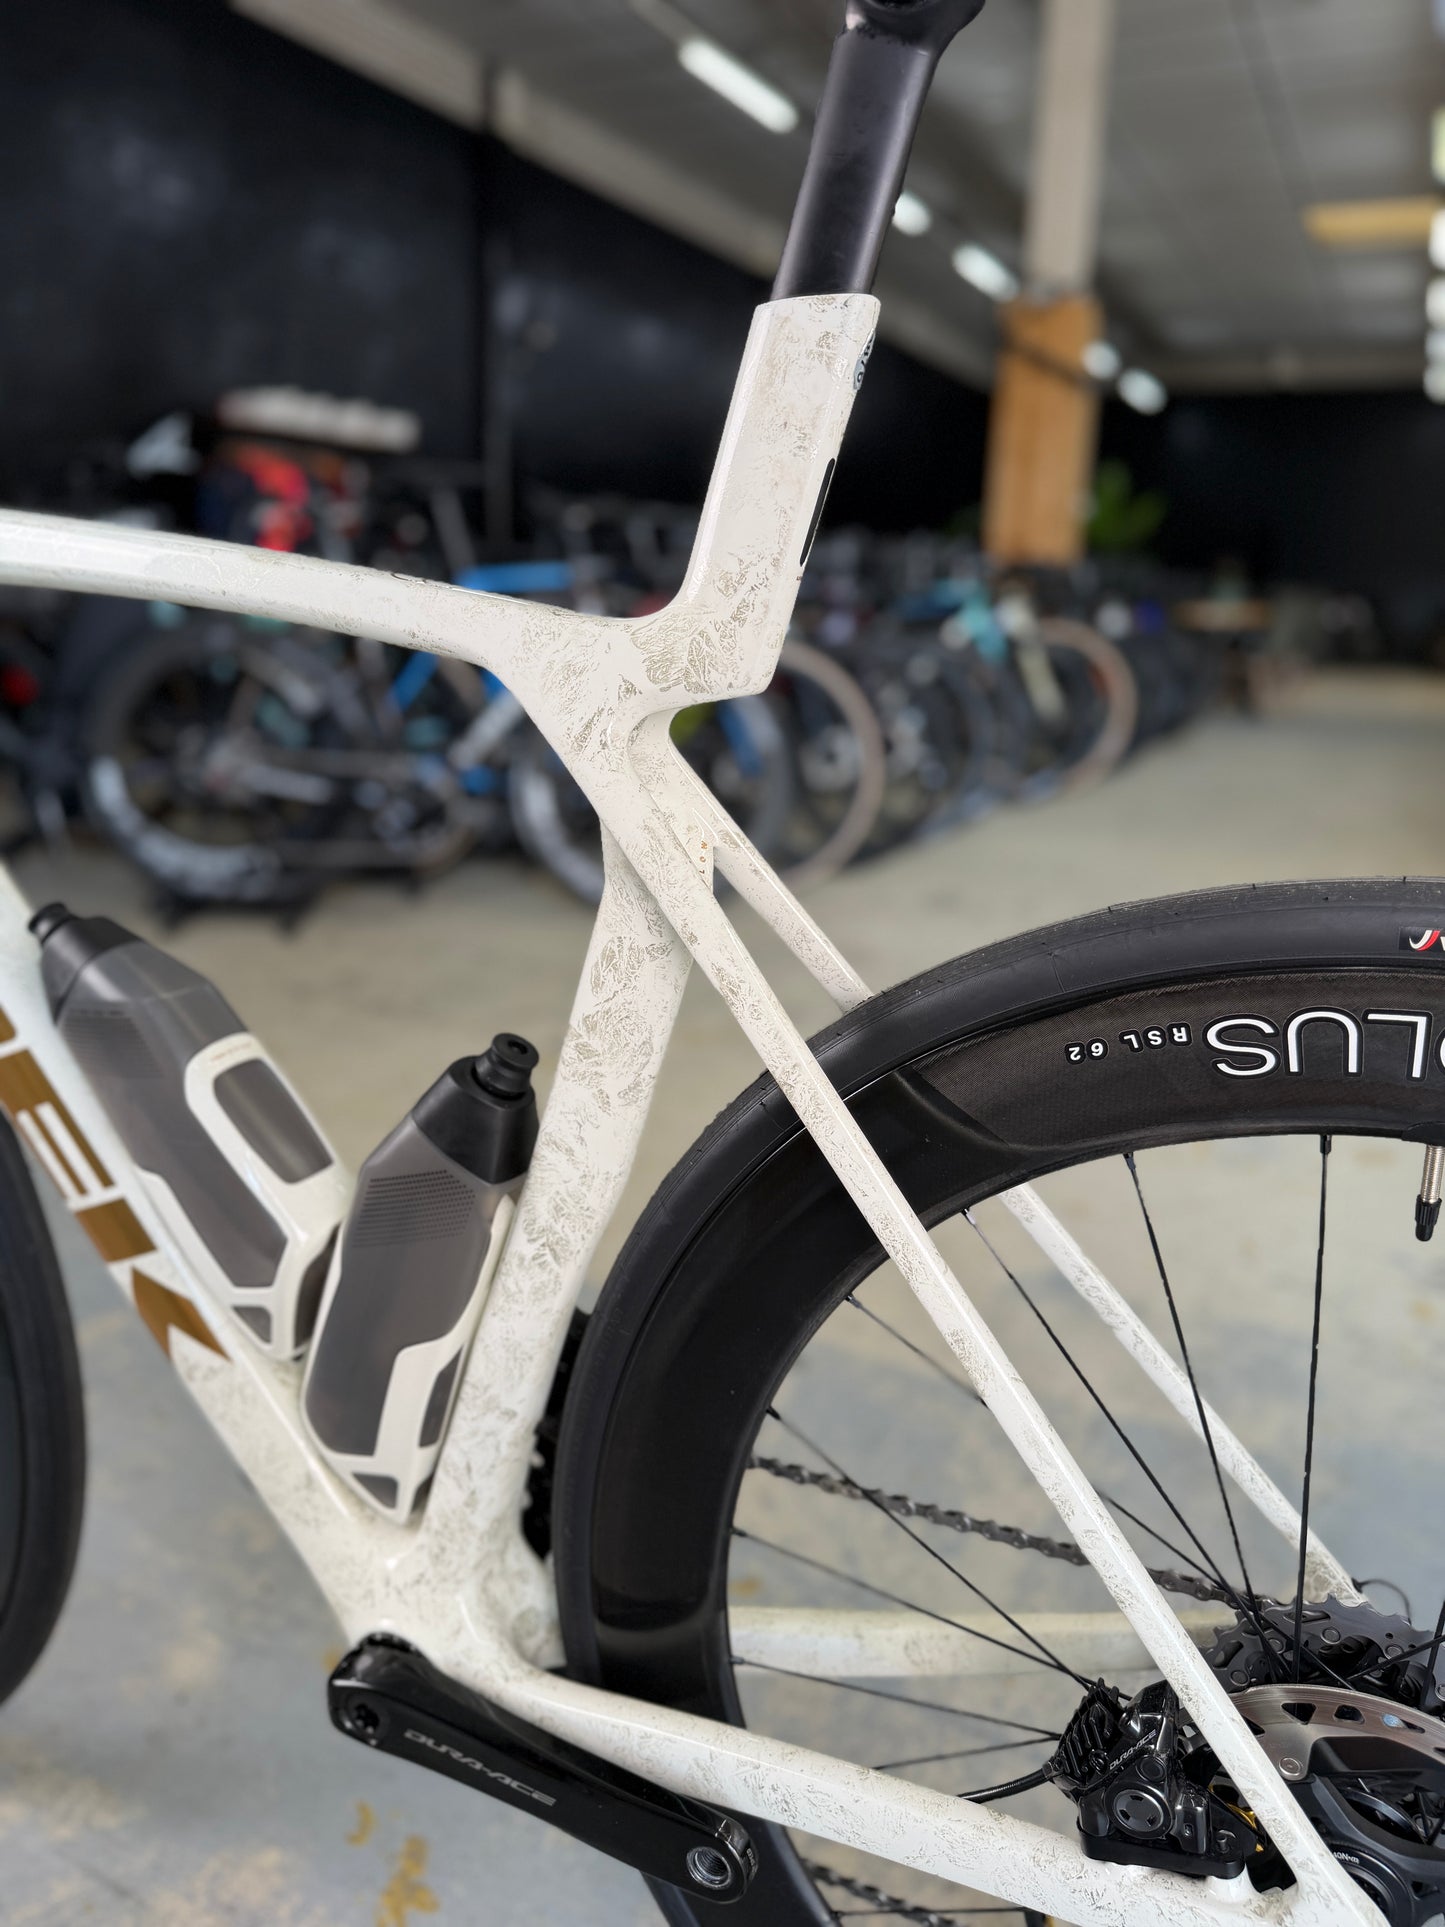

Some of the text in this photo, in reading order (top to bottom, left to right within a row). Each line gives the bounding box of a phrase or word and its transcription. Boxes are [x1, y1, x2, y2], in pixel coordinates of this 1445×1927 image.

[1068, 1010, 1445, 1079] LUS RSL 62
[404, 1728, 557, 1806] DURA-ACE
[1109, 1728, 1157, 1770] DURA-ACE
